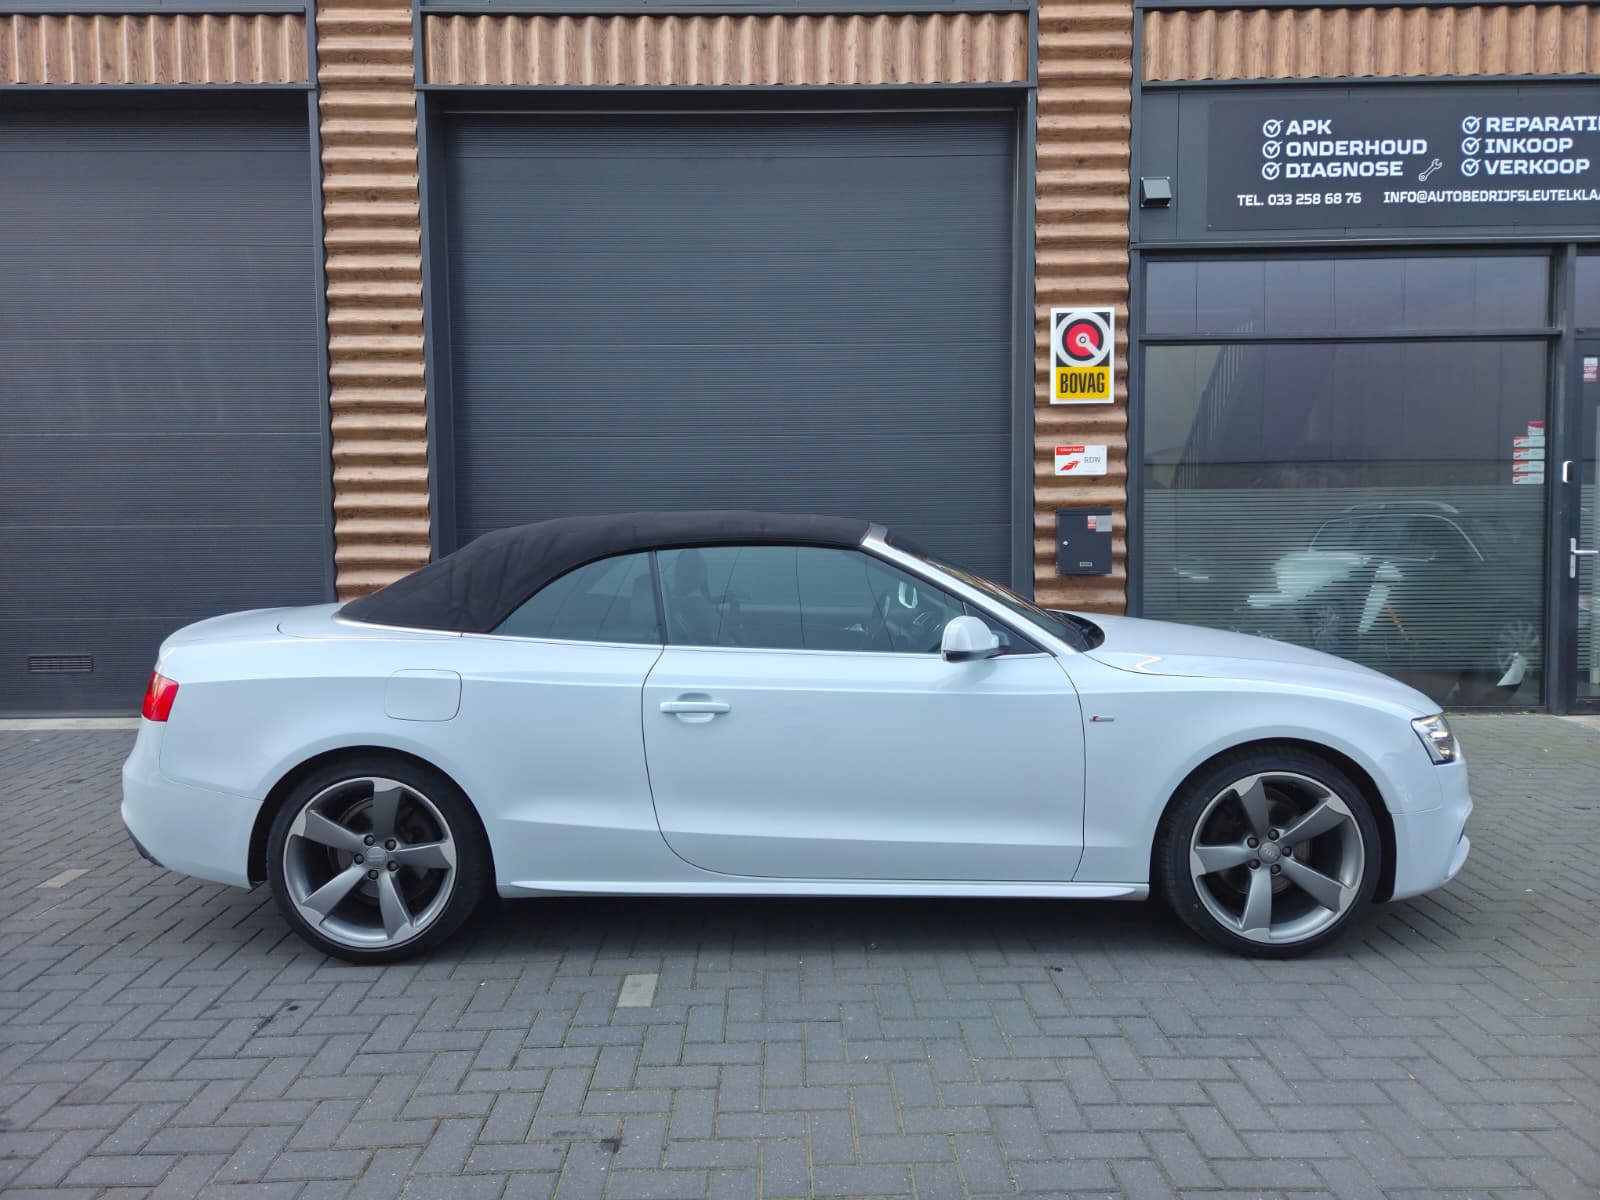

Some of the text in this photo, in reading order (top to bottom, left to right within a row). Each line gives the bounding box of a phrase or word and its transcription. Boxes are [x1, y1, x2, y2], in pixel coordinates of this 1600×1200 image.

[1286, 119, 1332, 135] APK
[1485, 115, 1600, 132] REPARATI
[1286, 139, 1427, 157] ONDERHOUD
[1485, 137, 1573, 154] INKOOP
[1286, 161, 1403, 178] DIAGNOSE
[1485, 158, 1590, 175] VERKOOP
[1237, 192, 1362, 206] TEL. 033 258 68 76
[1383, 189, 1600, 203] INFO@AUTOBEDRIJFSLEUTELKLA
[1060, 372, 1105, 393] BOVAG
